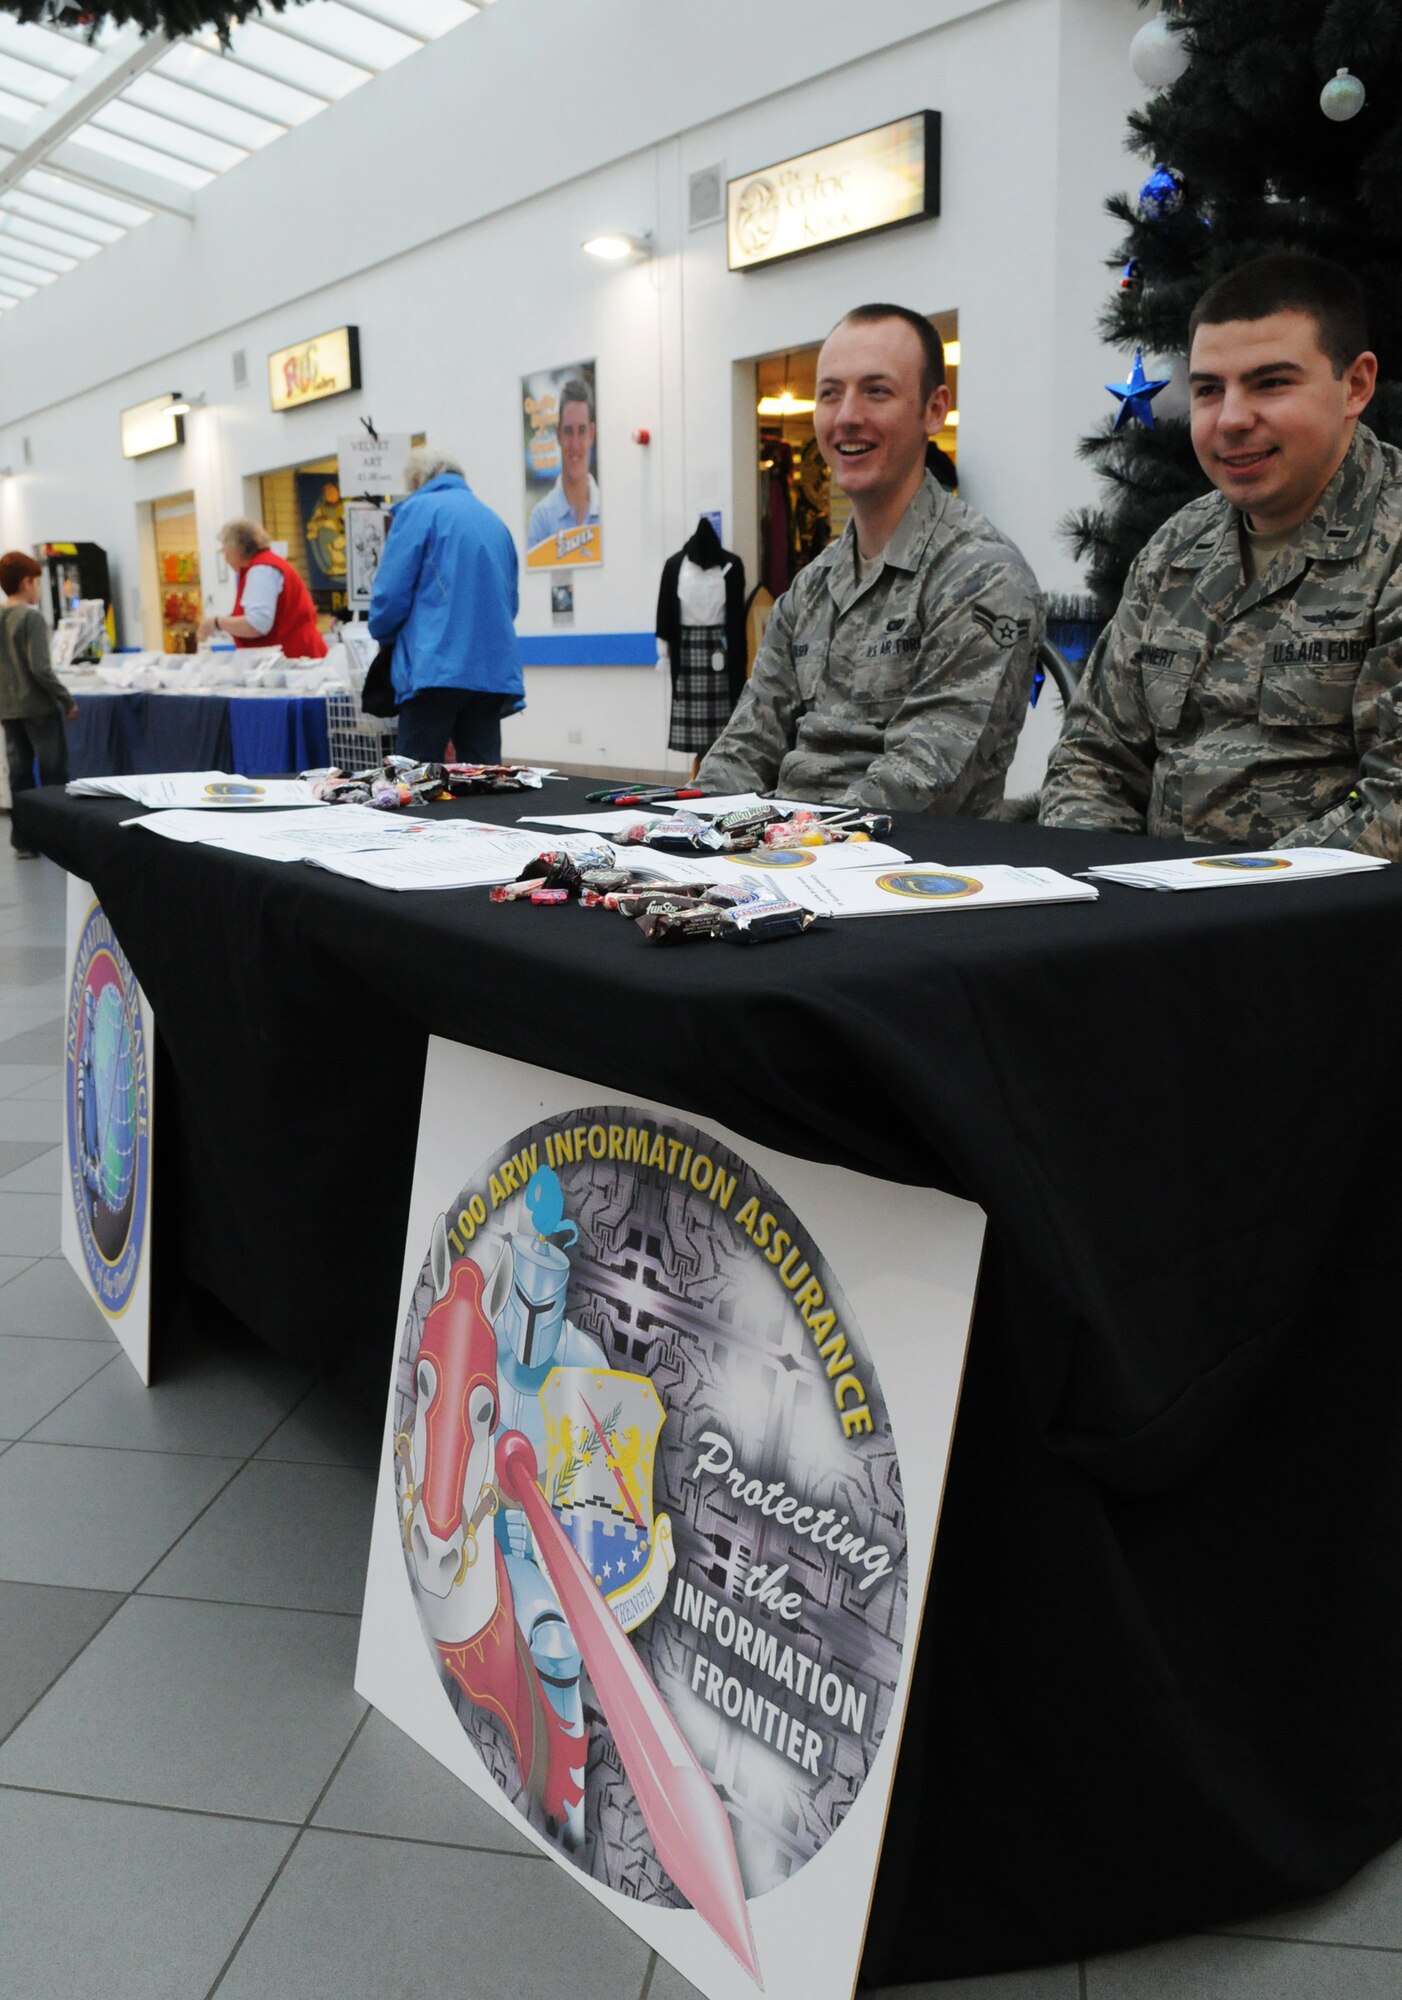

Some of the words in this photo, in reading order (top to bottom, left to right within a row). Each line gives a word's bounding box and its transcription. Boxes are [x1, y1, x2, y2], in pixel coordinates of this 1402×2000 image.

[1298, 640, 1322, 662] AIR
[447, 1193, 488, 1256] 100
[488, 1142, 538, 1209] ARW
[545, 1124, 737, 1211] INFORMATION
[735, 1196, 875, 1440] ASSURANCE
[693, 1430, 894, 1591] Protecting
[673, 1577, 868, 1735] INFORMATION
[744, 1564, 803, 1621] the
[691, 1653, 824, 1777] FRONTIER
